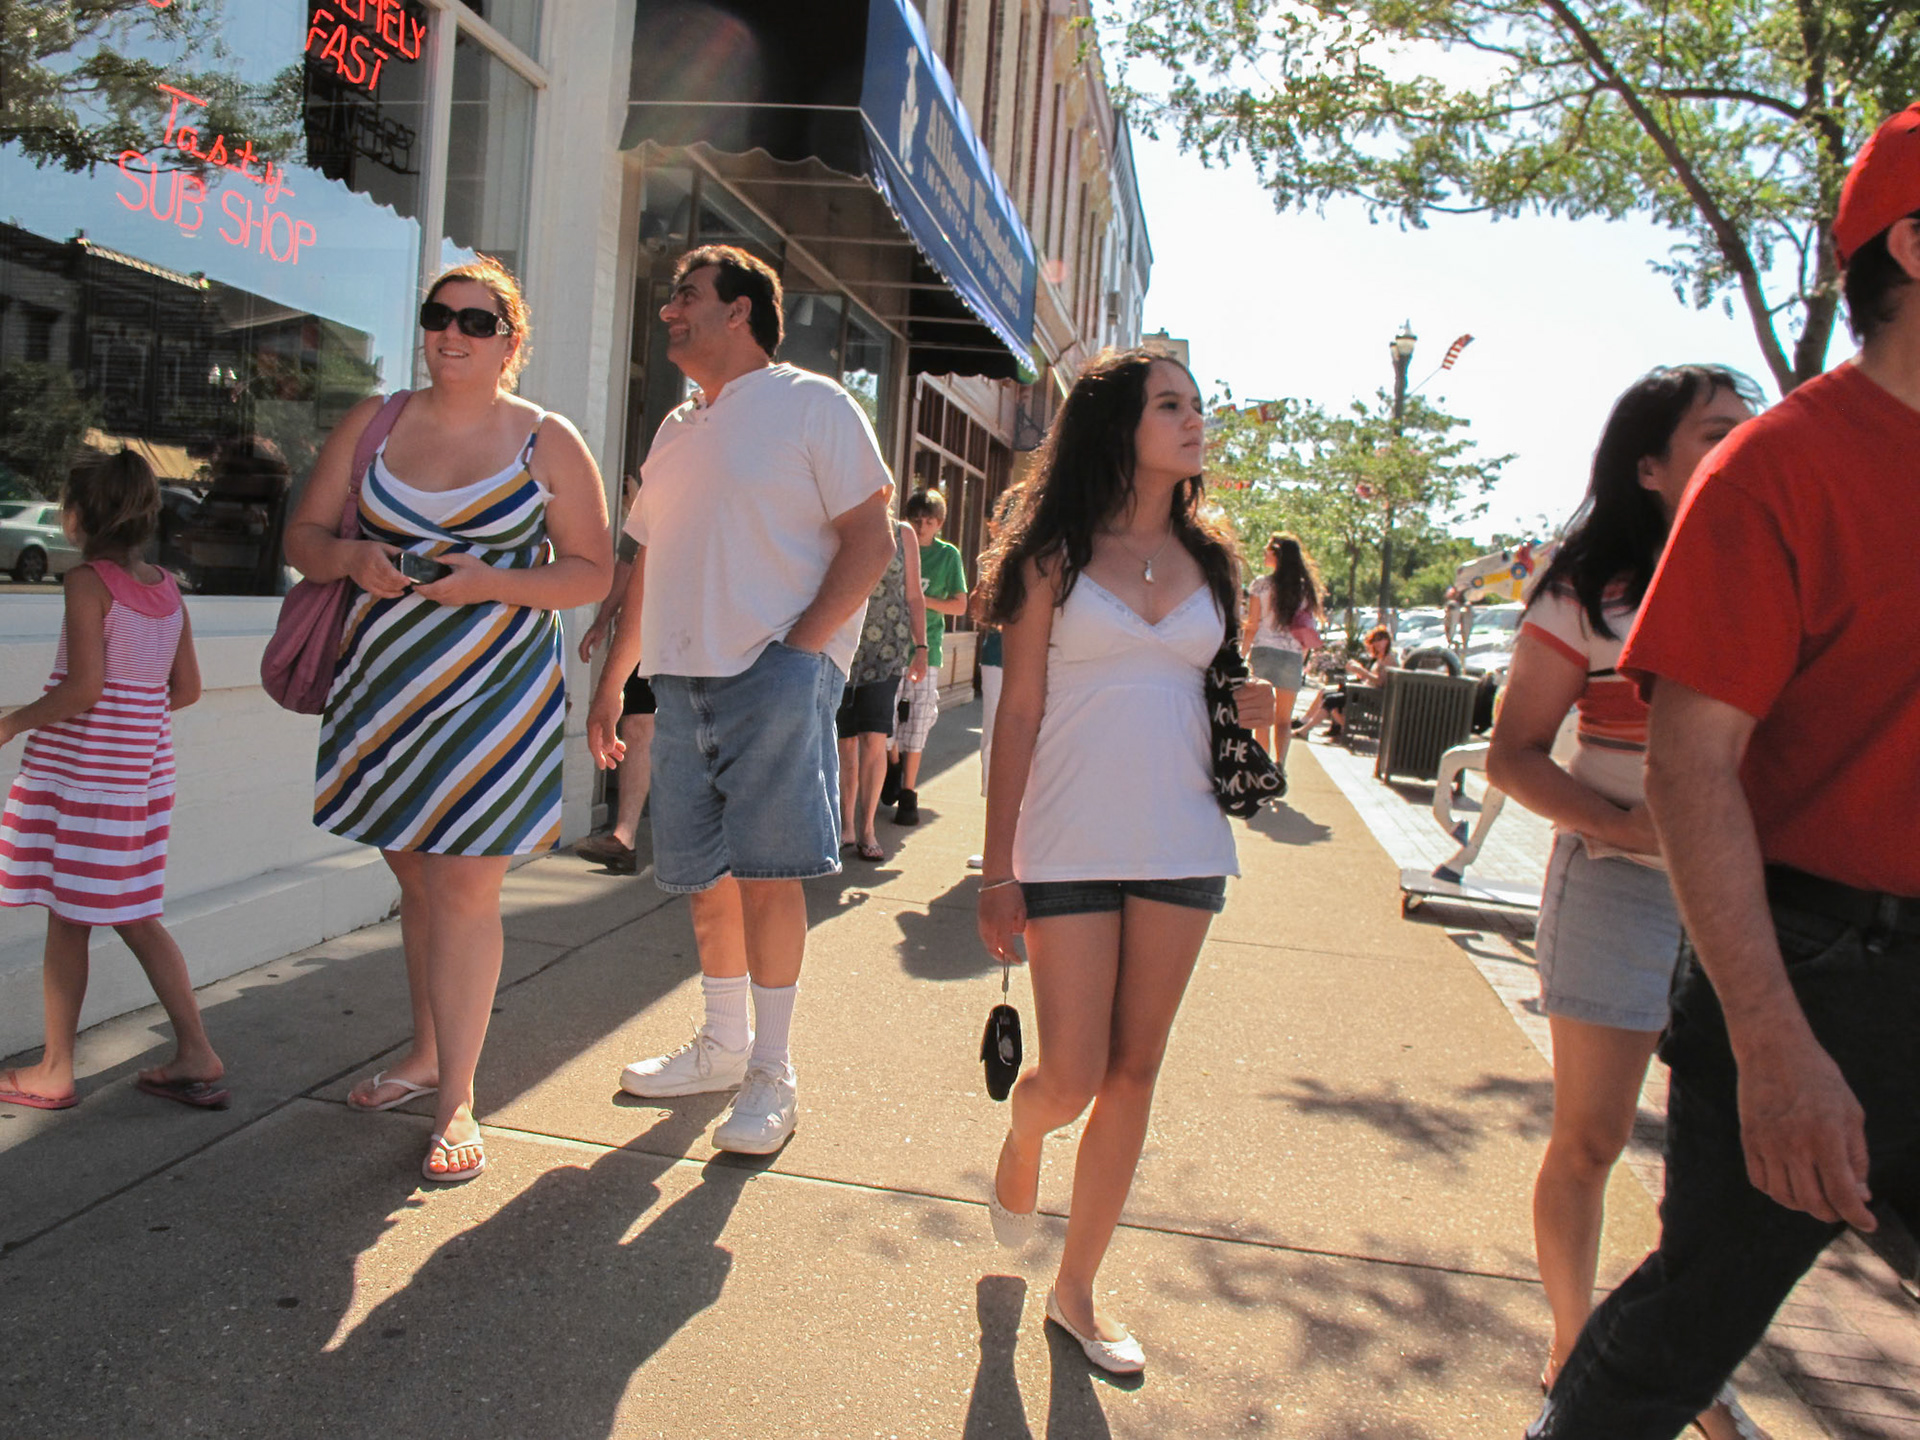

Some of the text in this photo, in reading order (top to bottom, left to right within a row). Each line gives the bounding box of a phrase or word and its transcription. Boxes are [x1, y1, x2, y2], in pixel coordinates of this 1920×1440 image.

[304, 9, 389, 90] FAST
[158, 83, 296, 203] Tasty
[116, 150, 317, 265] SUB SHOP
